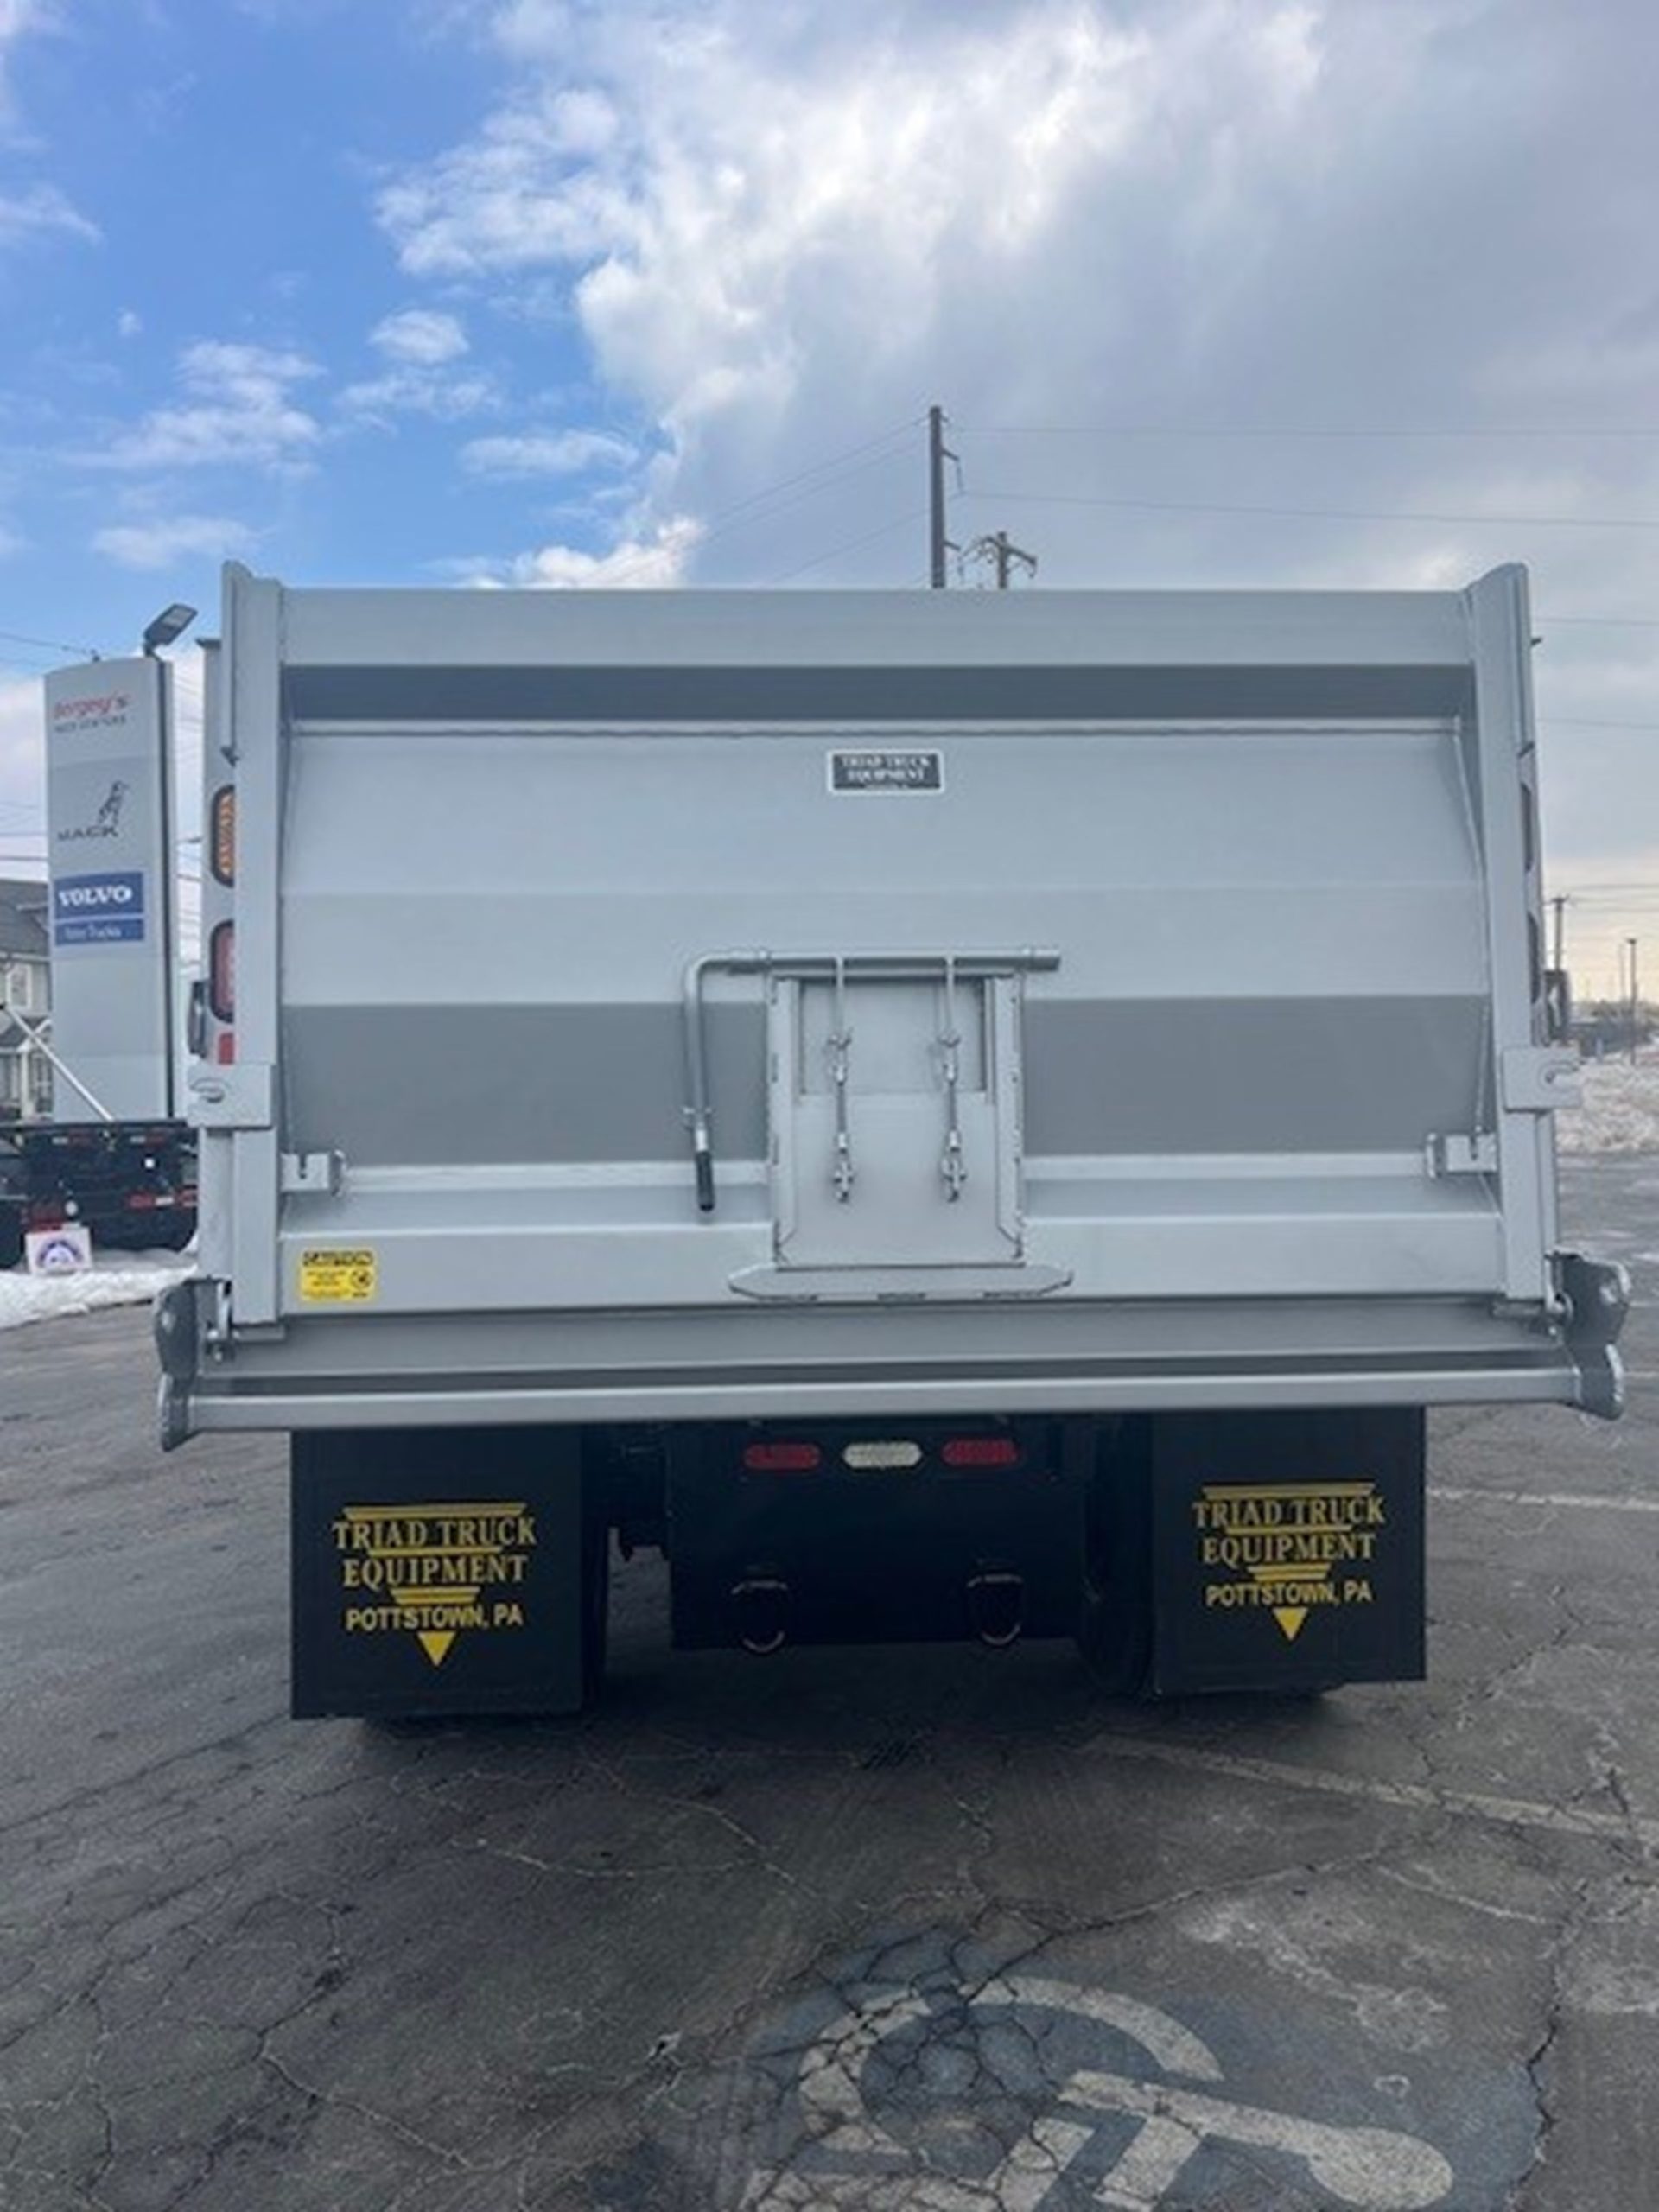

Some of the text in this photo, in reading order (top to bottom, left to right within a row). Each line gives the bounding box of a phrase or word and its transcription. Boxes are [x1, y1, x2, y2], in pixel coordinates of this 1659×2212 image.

[58, 826, 118, 841] MACK
[58, 886, 132, 906] VOLVO
[1192, 1496, 1386, 1528] TRIAD TRUCK
[332, 1516, 537, 1550] TRIAD TRUCK
[1202, 1533, 1375, 1569] EQUIPMENT
[343, 1555, 528, 1592] EQUIPMENT
[1205, 1580, 1374, 1607] POTTSTOWN, PA
[346, 1604, 524, 1631] POTTSTOWN, PA
